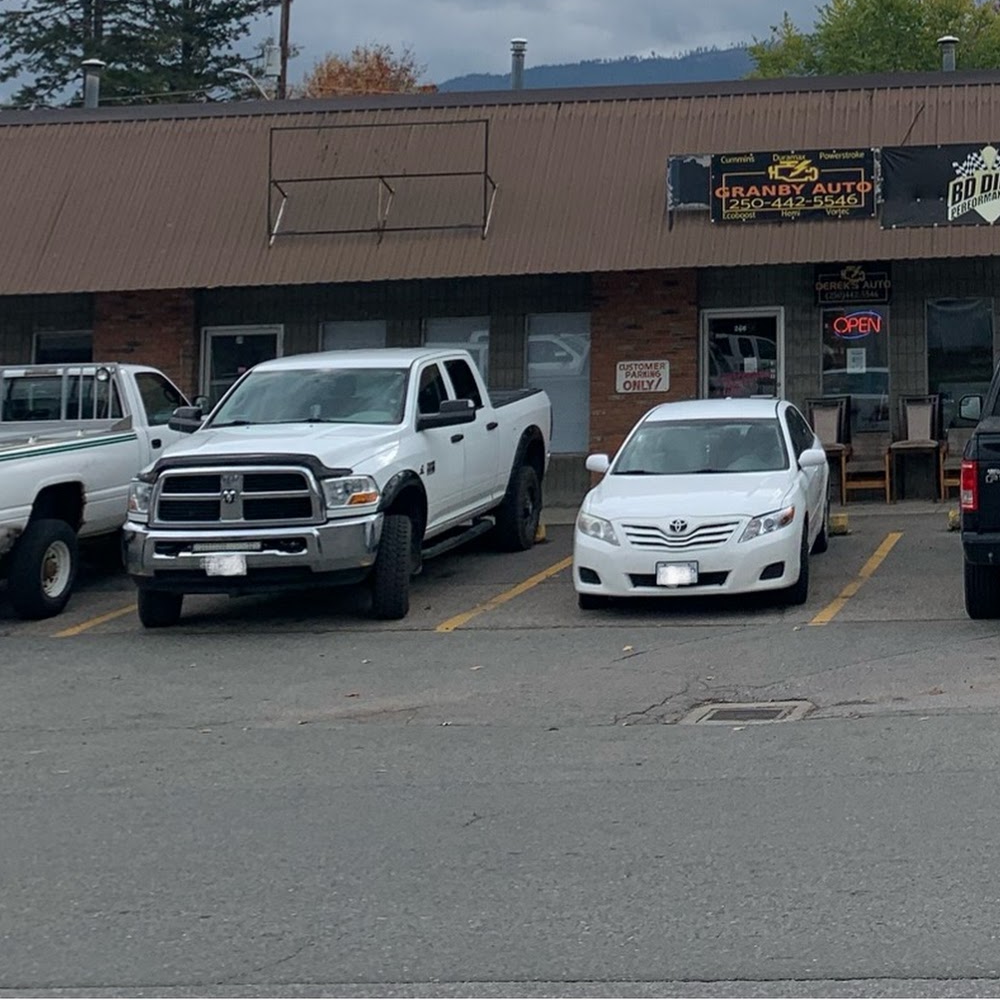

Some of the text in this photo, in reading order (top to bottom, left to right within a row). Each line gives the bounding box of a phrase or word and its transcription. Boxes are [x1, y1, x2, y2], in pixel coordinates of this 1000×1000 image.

[720, 155, 755, 164] Cummins
[772, 153, 806, 161] Duramax
[819, 151, 865, 160] Powerstroke
[715, 181, 872, 198] GRANBY AUTO
[951, 177, 976, 206] BD
[729, 193, 858, 210] 250-442-5546
[862, 279, 892, 290] AUTO
[834, 317, 881, 333] OPEN
[619, 362, 666, 371] CUSTOMER
[625, 370, 661, 379] PARKING
